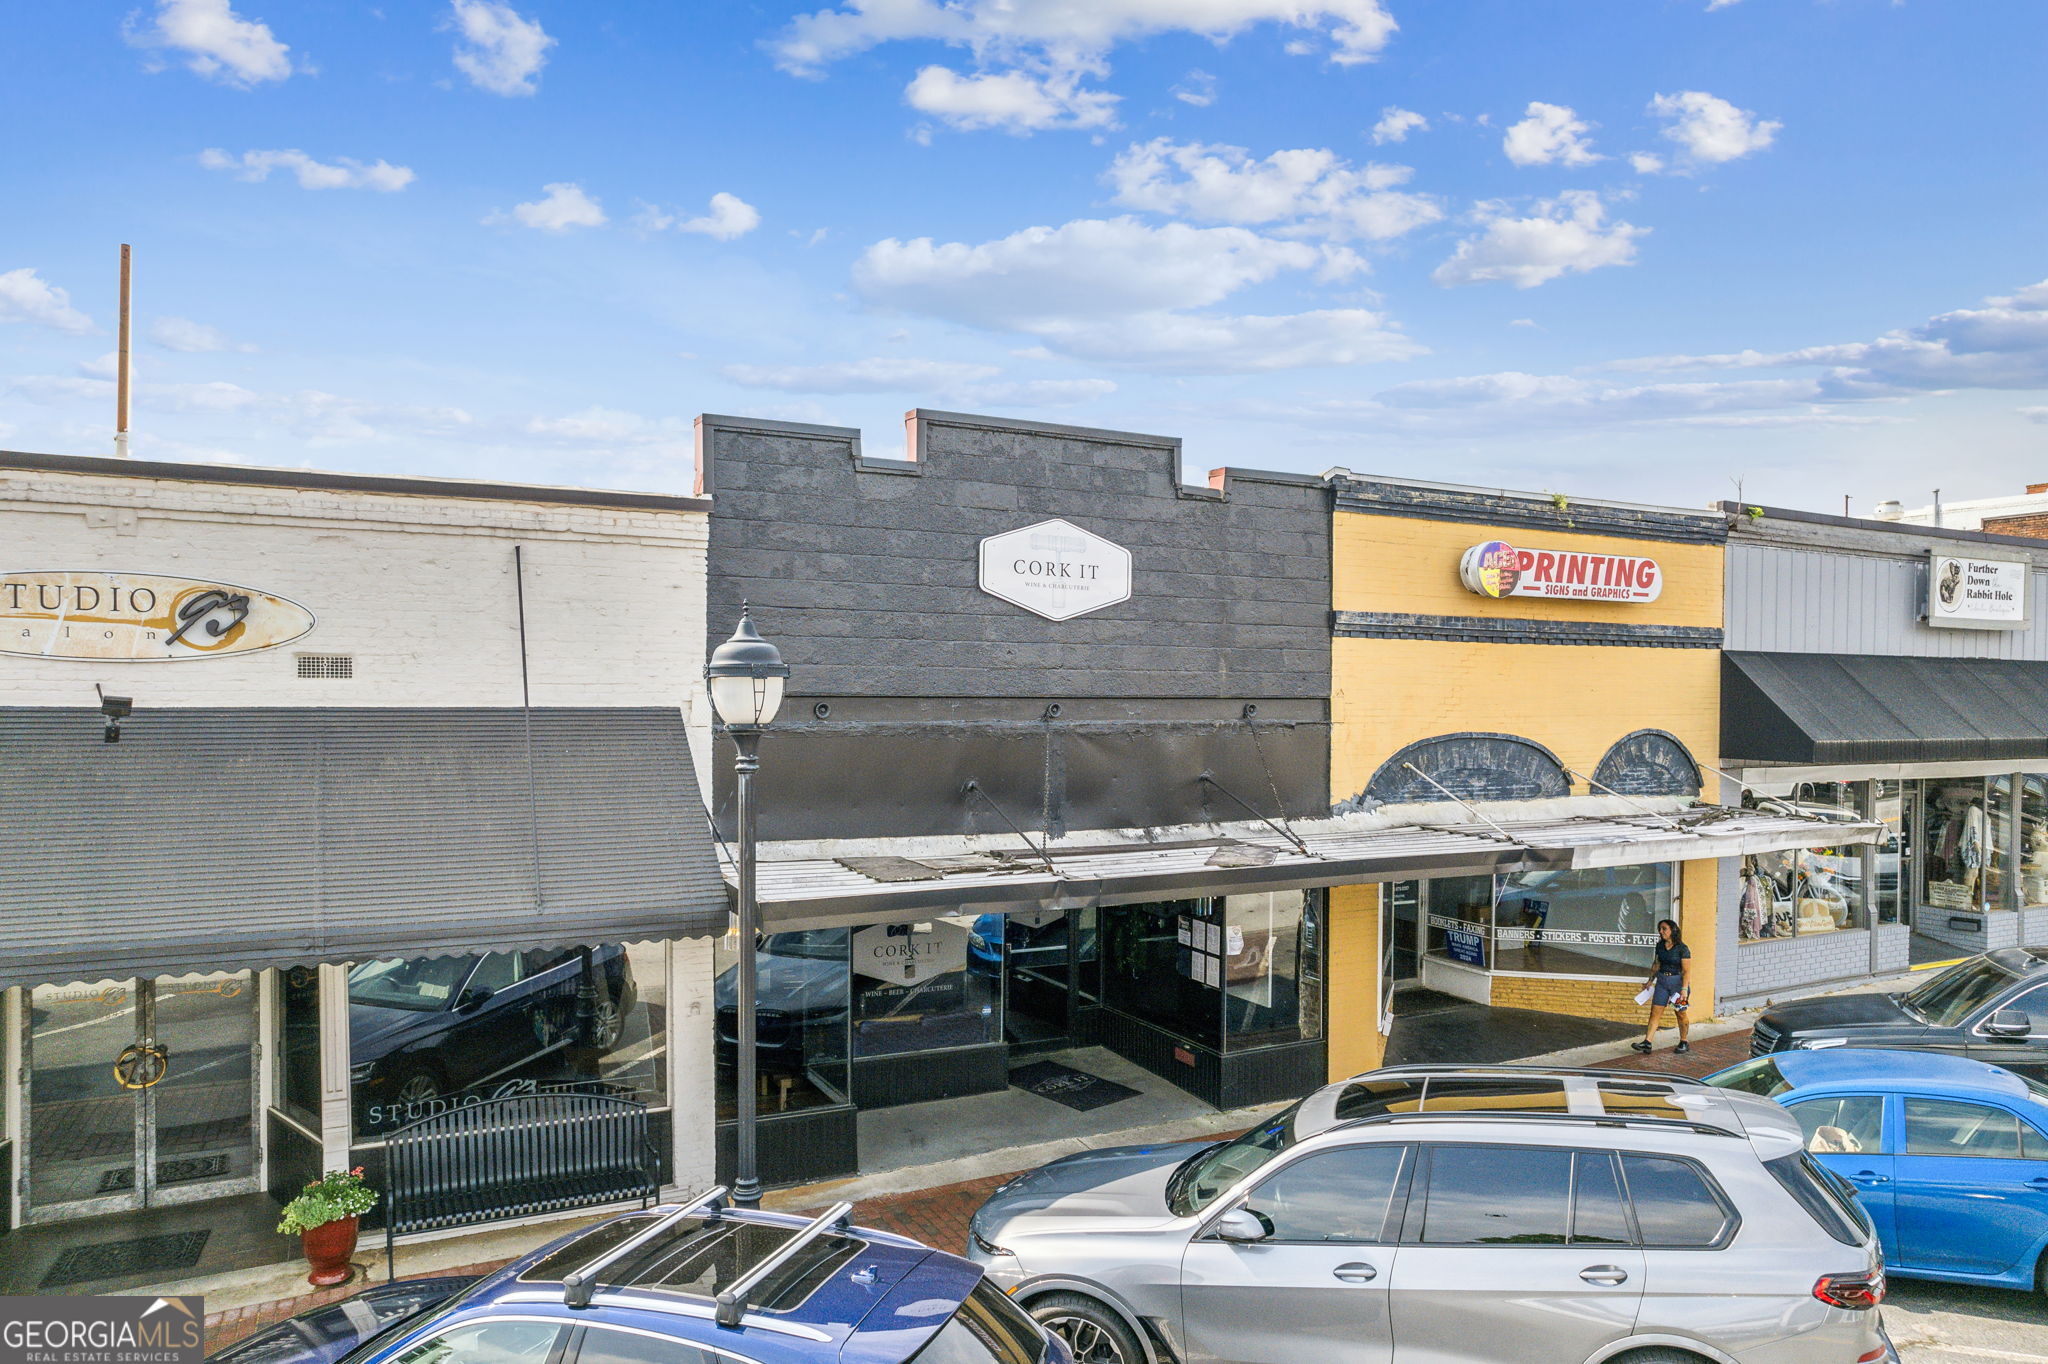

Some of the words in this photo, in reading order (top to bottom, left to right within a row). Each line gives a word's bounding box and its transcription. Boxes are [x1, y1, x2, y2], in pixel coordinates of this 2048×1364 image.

[1013, 559, 1072, 577] CORK
[1079, 564, 1099, 580] IT
[1517, 550, 1656, 589] PRINTING
[1968, 562, 1998, 574] Further
[1967, 575, 1990, 587] Down
[4, 583, 156, 613] TUDIO
[1544, 584, 1570, 597] SIGNS
[1572, 586, 1588, 597] and
[1590, 586, 1630, 600] GRAPHICS
[1966, 588, 1993, 600] Rabbit
[1994, 590, 2013, 601] Hole
[1430, 915, 1459, 930] BOOKLETS
[1463, 923, 1486, 936] FAXING
[1447, 930, 1480, 947] TRUMP
[1497, 929, 1535, 940] BANNERS
[1541, 932, 1582, 943] STICKERS
[1588, 933, 1626, 944] POSTERS
[873, 943, 920, 958] CORK
[927, 941, 943, 955] IT
[865, 990, 883, 998] WINE
[888, 988, 905, 996] BEER
